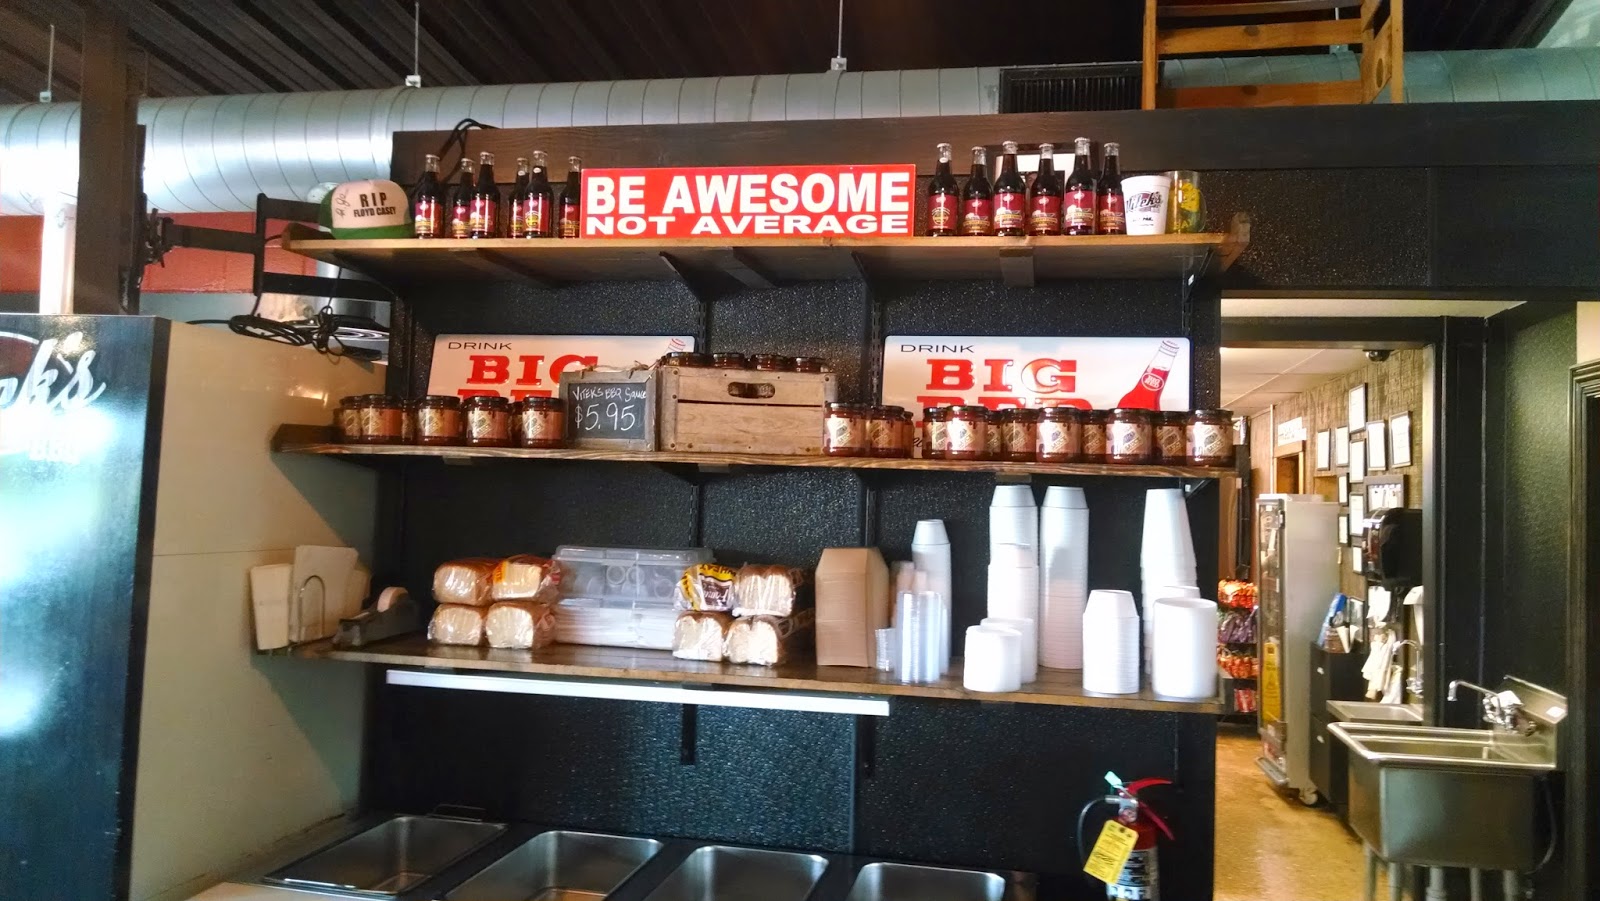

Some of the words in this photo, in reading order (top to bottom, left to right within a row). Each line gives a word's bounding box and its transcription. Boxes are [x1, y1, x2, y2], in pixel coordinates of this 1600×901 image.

[359, 191, 388, 208] RIP
[586, 175, 646, 215] BE
[661, 171, 910, 214] AWESOME
[353, 207, 375, 218] FLOYD
[376, 206, 397, 216] CASEY
[585, 215, 676, 236] NOT
[690, 213, 909, 235] AVERAGE
[448, 340, 513, 351] DRINK
[900, 343, 976, 354] DRINK
[925, 357, 1078, 394] BIG
[605, 387, 622, 401] BBQ
[624, 387, 647, 402] Sauce
[574, 402, 636, 431] $5.95
